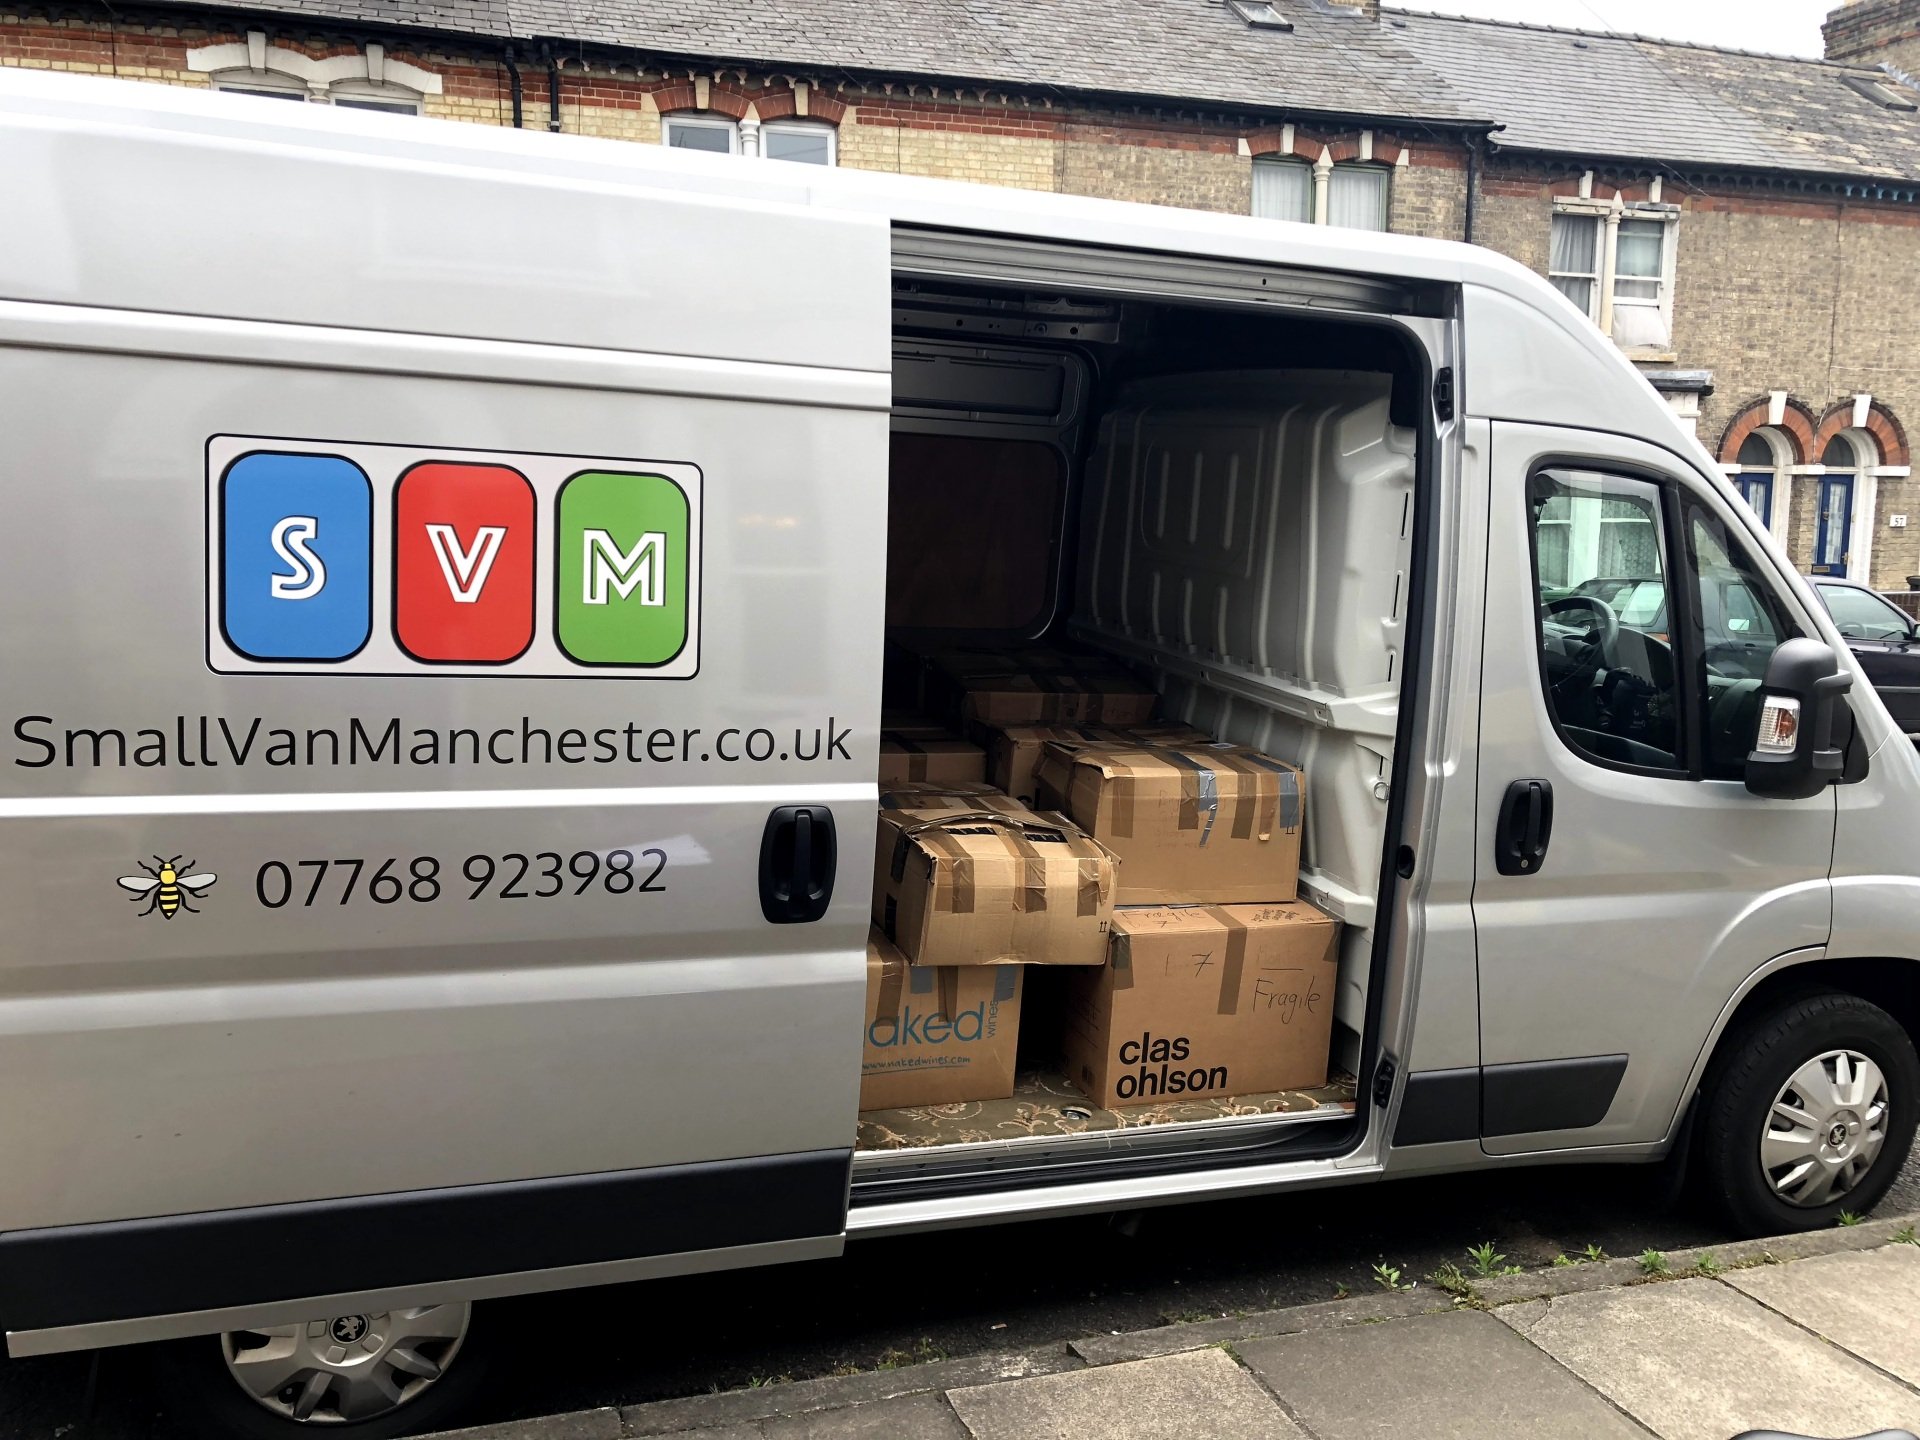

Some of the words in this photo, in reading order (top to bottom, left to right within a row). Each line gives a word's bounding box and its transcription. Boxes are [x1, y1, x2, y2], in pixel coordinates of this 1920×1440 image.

[1894, 517, 1904, 526] 57
[270, 516, 326, 601] S
[424, 523, 507, 604] V
[581, 528, 666, 607] M
[13, 715, 853, 769] SmallVanManchester.co.uk
[256, 856, 441, 909] 07768
[462, 848, 668, 901] 923982
[864, 1000, 985, 1047] aked
[1252, 975, 1321, 1024] Fragile
[1119, 1031, 1191, 1065] clas
[1116, 1064, 1228, 1099] ohlson
